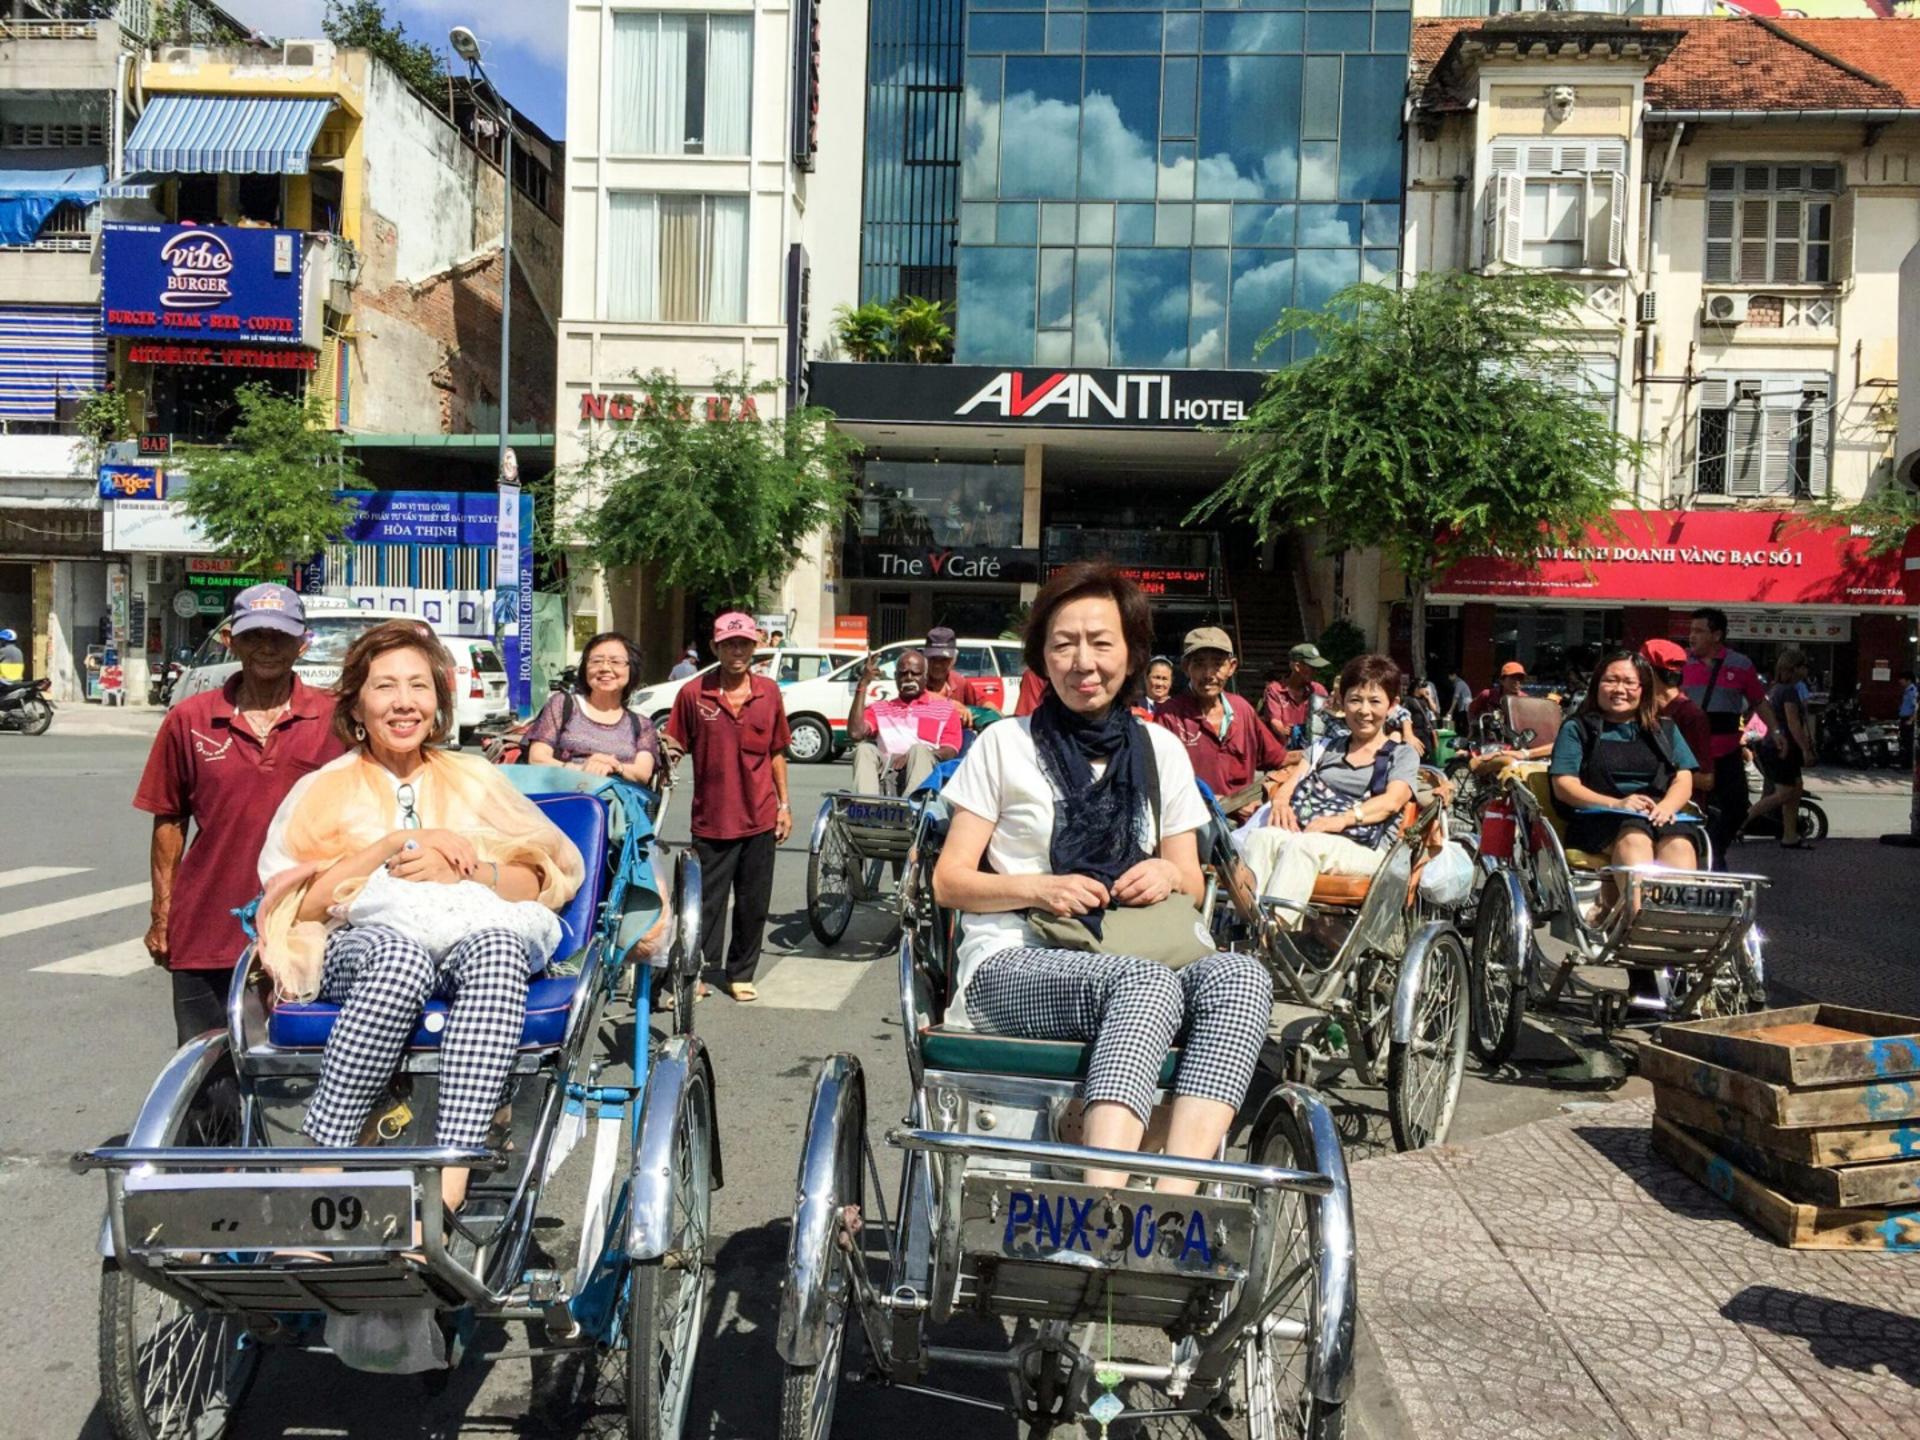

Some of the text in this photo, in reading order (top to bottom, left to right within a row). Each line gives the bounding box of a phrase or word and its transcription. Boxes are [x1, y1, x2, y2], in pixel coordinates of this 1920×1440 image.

[167, 276, 229, 292] BURGER
[108, 310, 293, 332] BURGER STEAK BEER COFFEE
[128, 346, 316, 369] AUTHENTIC VIETNAMESE
[954, 371, 1249, 422] AVANTI HOTEL
[141, 436, 168, 450] BAR
[111, 472, 154, 495] Tiger
[384, 523, 458, 539] HÒA THỊNH
[878, 553, 923, 575] The
[947, 556, 1001, 578] Café
[1613, 547, 1675, 562] DOANH
[1679, 545, 1726, 564] VÀNG
[1730, 549, 1766, 567] BẠC
[1769, 547, 1792, 565] SỐ
[1795, 552, 1803, 565] 1
[189, 575, 206, 585] THE
[520, 569, 533, 681] HOA THINH GROUP
[311, 1196, 363, 1231] 09
